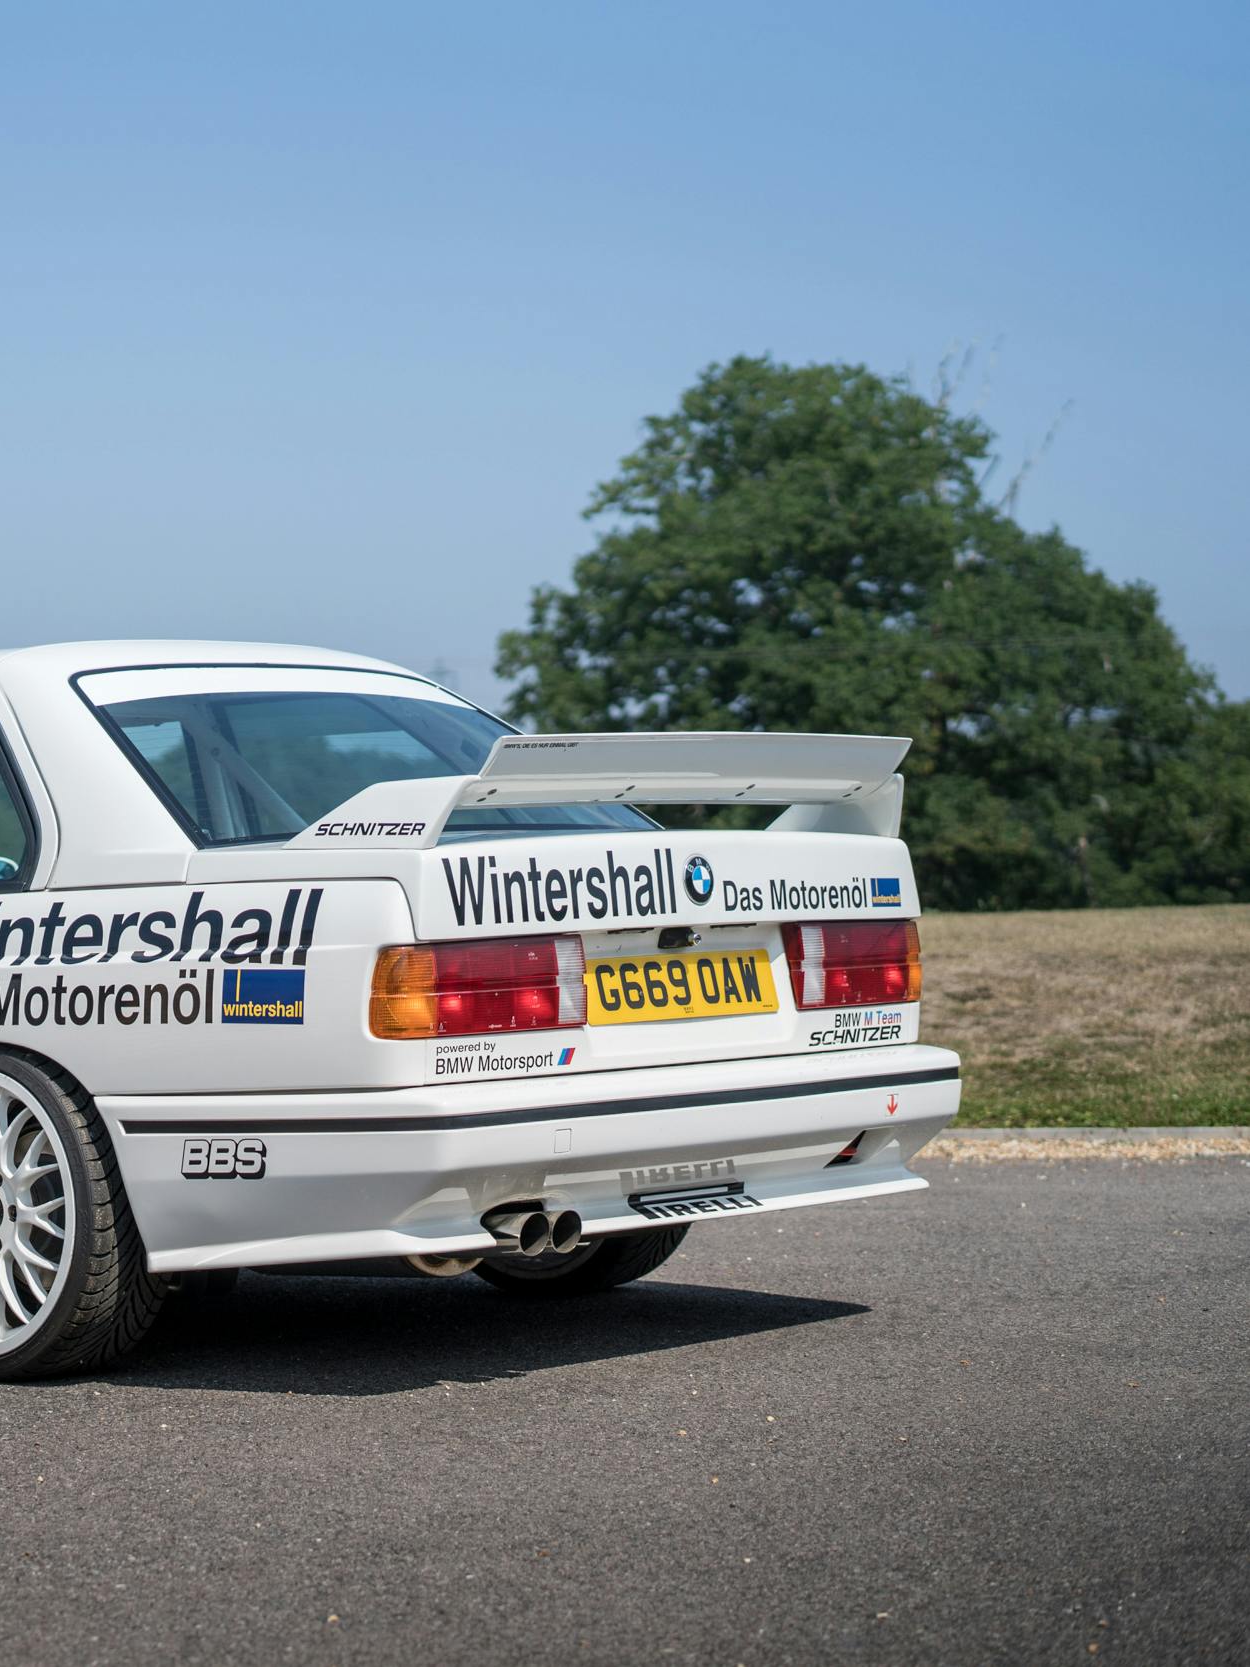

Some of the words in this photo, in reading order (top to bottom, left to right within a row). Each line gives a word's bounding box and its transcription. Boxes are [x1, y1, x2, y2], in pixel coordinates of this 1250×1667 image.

[315, 823, 426, 836] SCHNITZER
[442, 848, 677, 926] Wintershall
[723, 880, 763, 911] Das
[769, 877, 868, 910] Motorenöl
[595, 960, 692, 1012] G669
[697, 956, 762, 1004] OAW
[223, 1001, 303, 1018] wintershall
[835, 1012, 862, 1028] BMW
[864, 1011, 873, 1026] M
[876, 1010, 902, 1024] Team
[809, 1025, 901, 1047] SCHNITZER
[436, 1042, 481, 1056] powered
[483, 1042, 496, 1053] by
[436, 1056, 474, 1075] BMW
[478, 1051, 553, 1072] Motorsport
[181, 1139, 267, 1179] BBS
[628, 1181, 764, 1220] PIRELLI
